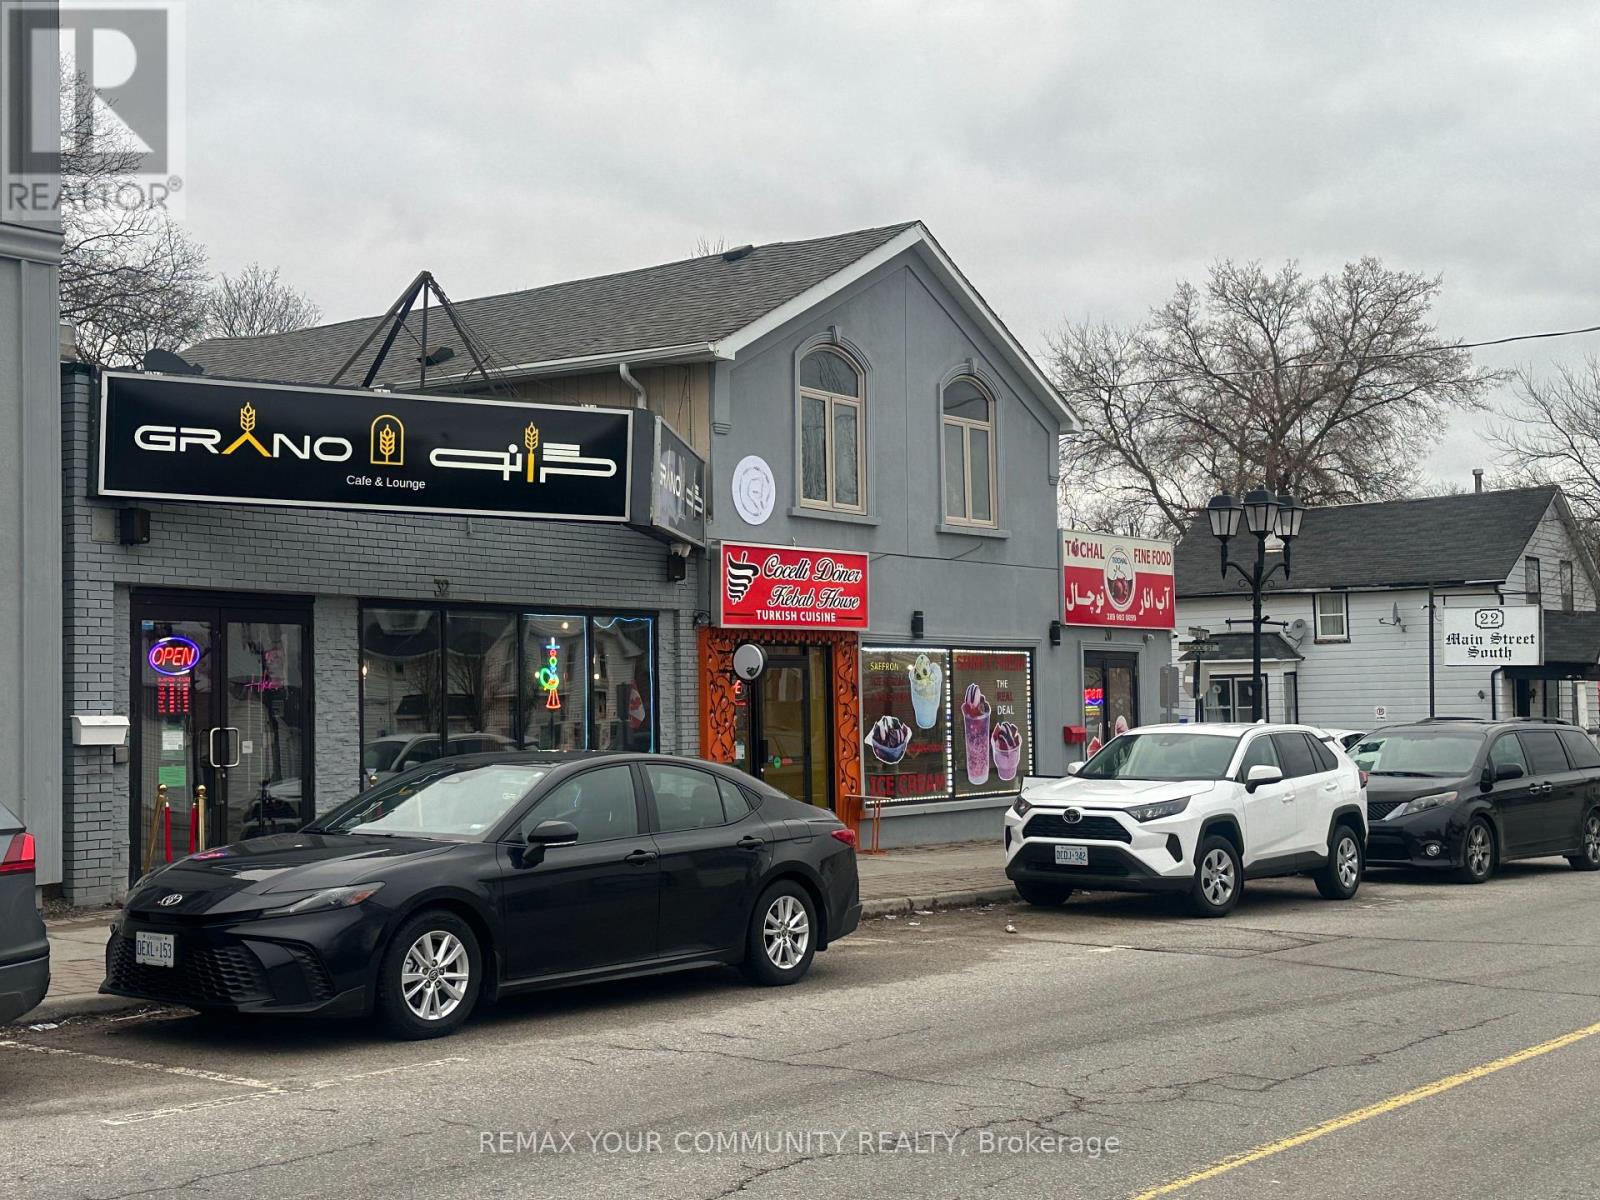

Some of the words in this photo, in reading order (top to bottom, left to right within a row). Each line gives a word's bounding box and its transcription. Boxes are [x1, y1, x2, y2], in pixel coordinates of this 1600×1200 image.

[134, 417, 353, 462] GRANO
[346, 474, 372, 487] Cafe
[374, 477, 383, 487] &
[386, 477, 426, 489] Lounge
[1133, 548, 1151, 564] FINE
[1152, 550, 1172, 566] FOOD
[763, 554, 811, 580] Cocelli
[812, 558, 863, 583] Döner
[767, 585, 815, 608] Kebab
[816, 587, 860, 609] House
[756, 610, 797, 621] TURKISH
[800, 612, 836, 623] CUISINE
[1480, 613, 1499, 625] 22
[1445, 632, 1483, 645] Main
[1489, 631, 1536, 645] Street
[151, 647, 195, 666] OPEN
[1467, 645, 1512, 660] South
[870, 661, 899, 671] SAFFRON
[996, 680, 1009, 688] THE
[997, 705, 1015, 715] DEAL
[869, 774, 895, 796] ICE
